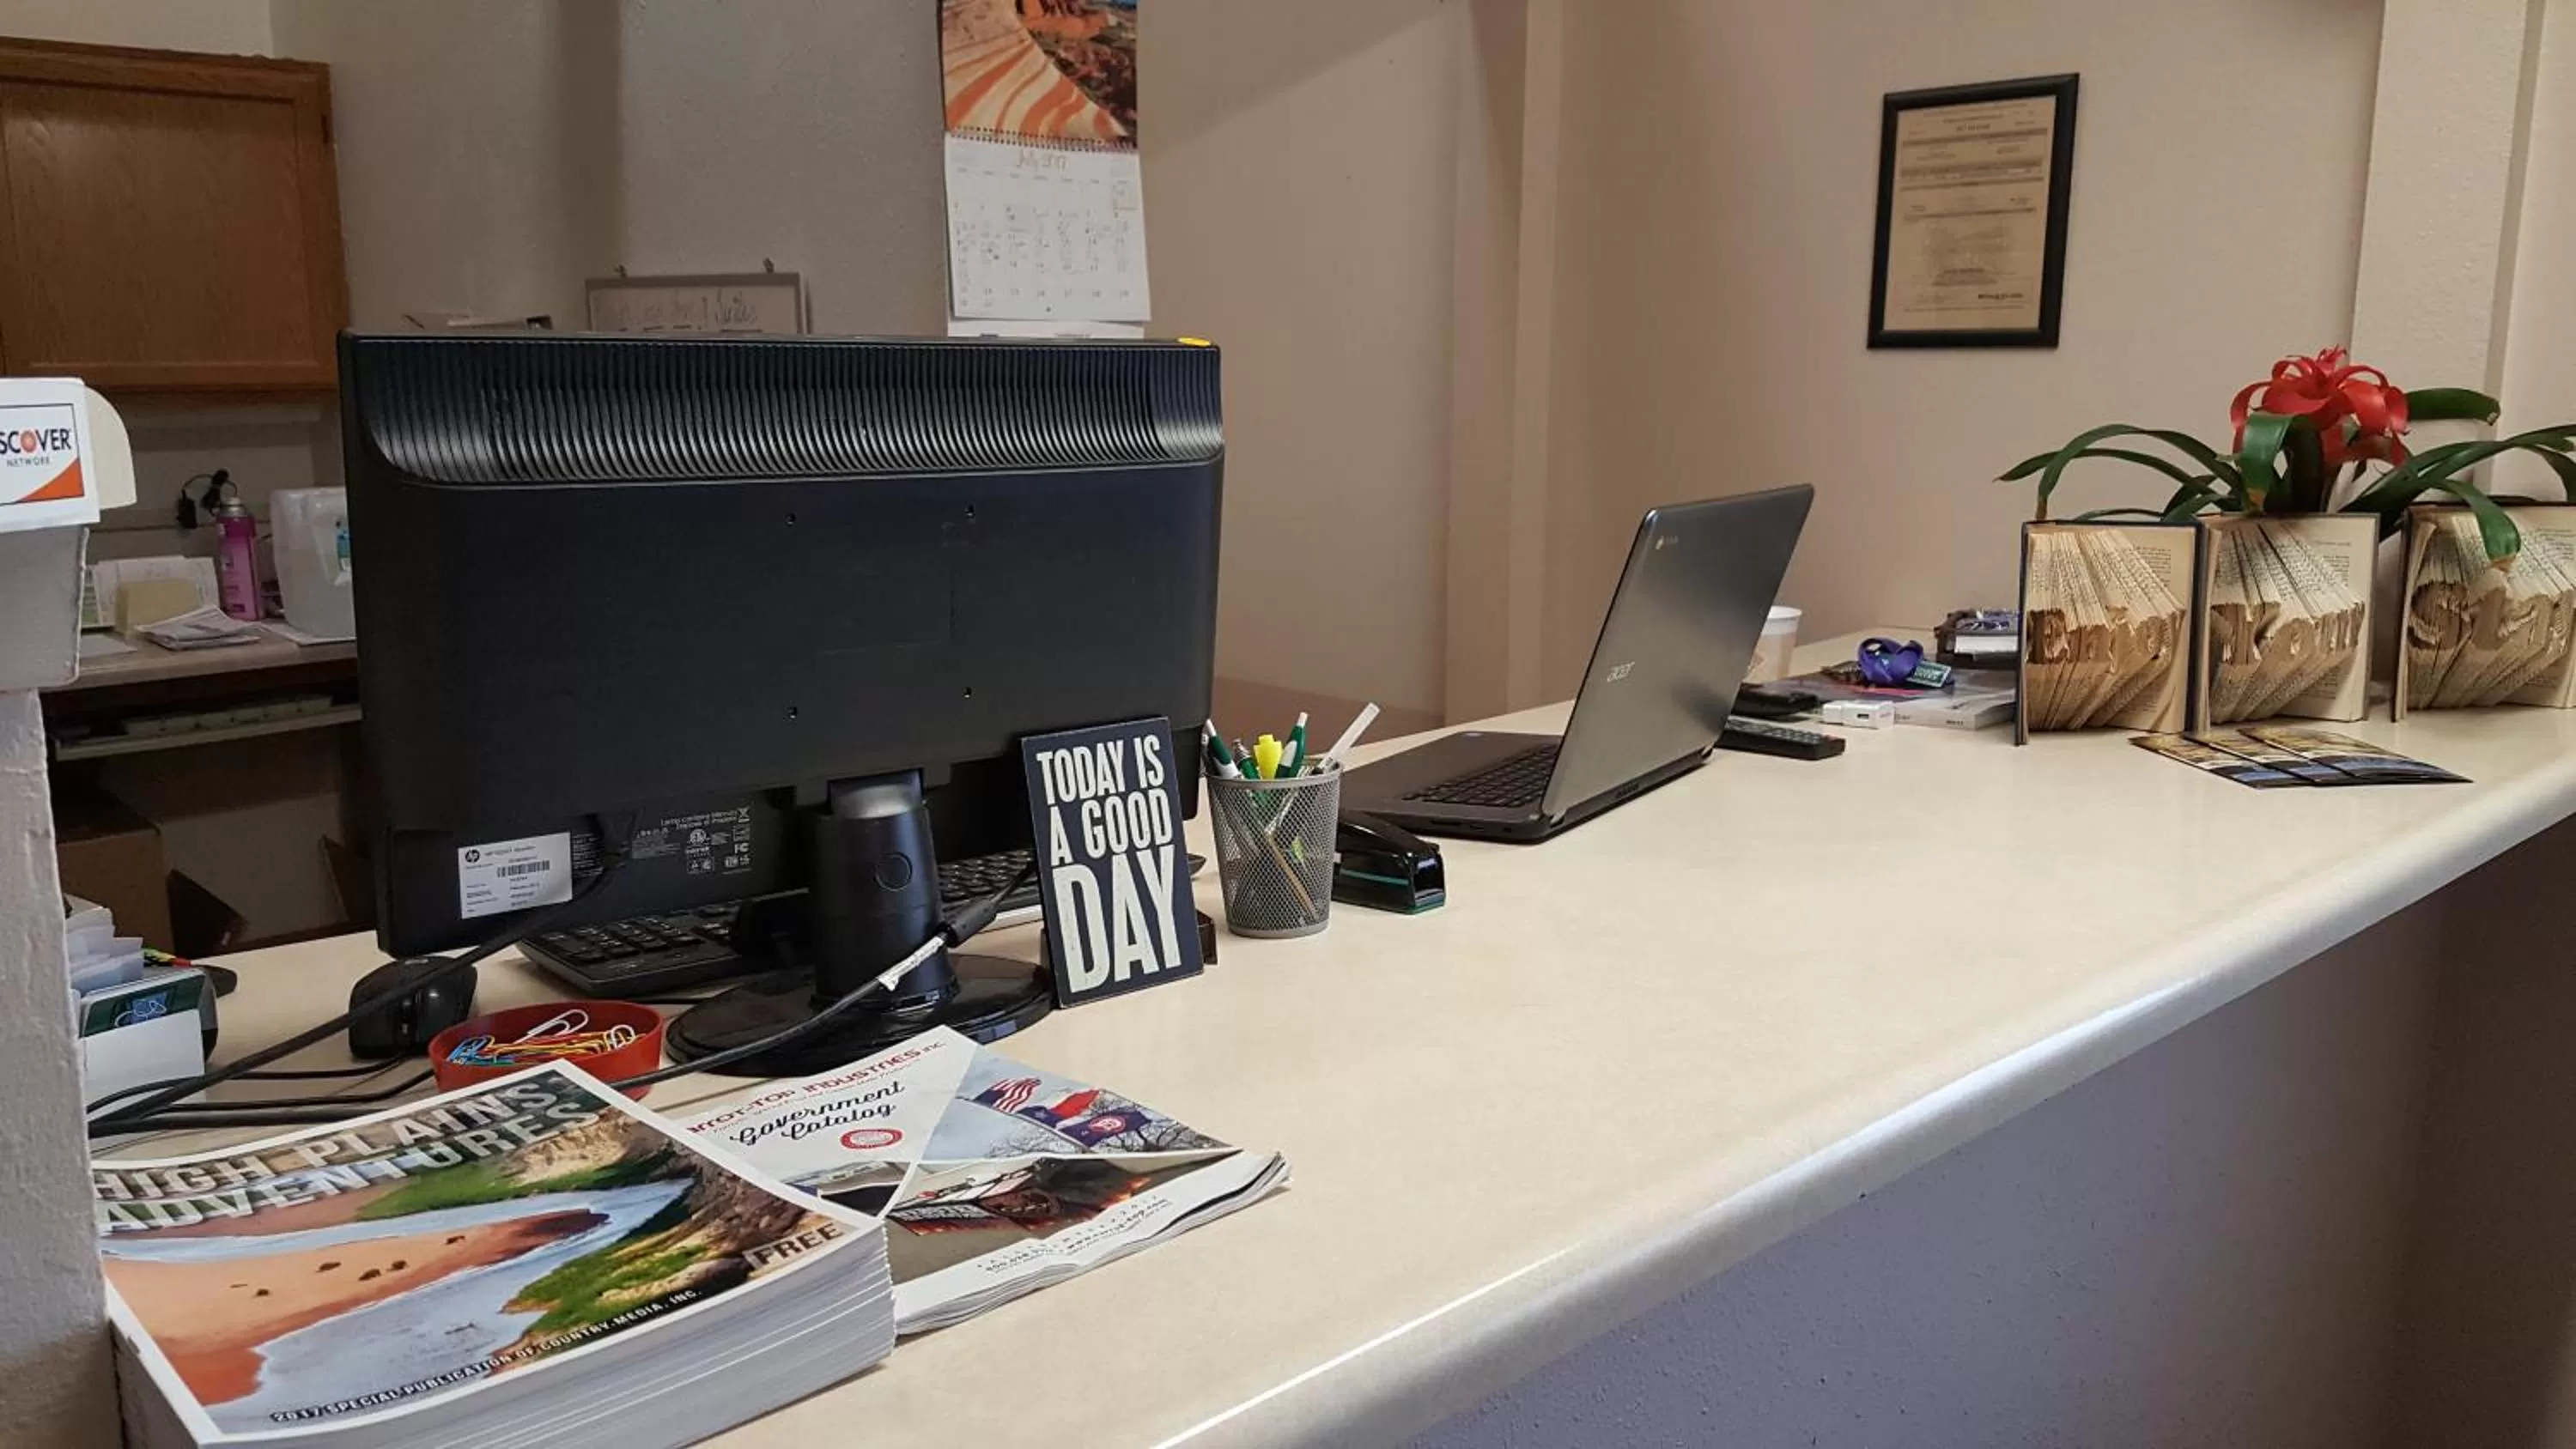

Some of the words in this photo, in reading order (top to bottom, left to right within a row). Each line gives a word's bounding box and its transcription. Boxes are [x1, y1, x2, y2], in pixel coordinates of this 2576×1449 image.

[1036, 739, 1126, 805] TODAY
[1133, 734, 1165, 789] IS
[1049, 806, 1073, 867] A
[1081, 788, 1174, 859] GOOD
[1052, 844, 1182, 993] DAY
[93, 1155, 276, 1200] HIGH
[296, 1082, 559, 1168] PLAINS
[729, 1080, 905, 1146] Government
[781, 1104, 896, 1141] Catalog
[94, 1101, 600, 1236] ADVENTURES
[753, 1222, 844, 1265] FREE
[270, 1406, 323, 1422] 2017
[325, 1388, 402, 1416] SPECIAL
[404, 1353, 513, 1397] PUBLICATION
[516, 1345, 535, 1358] OF
